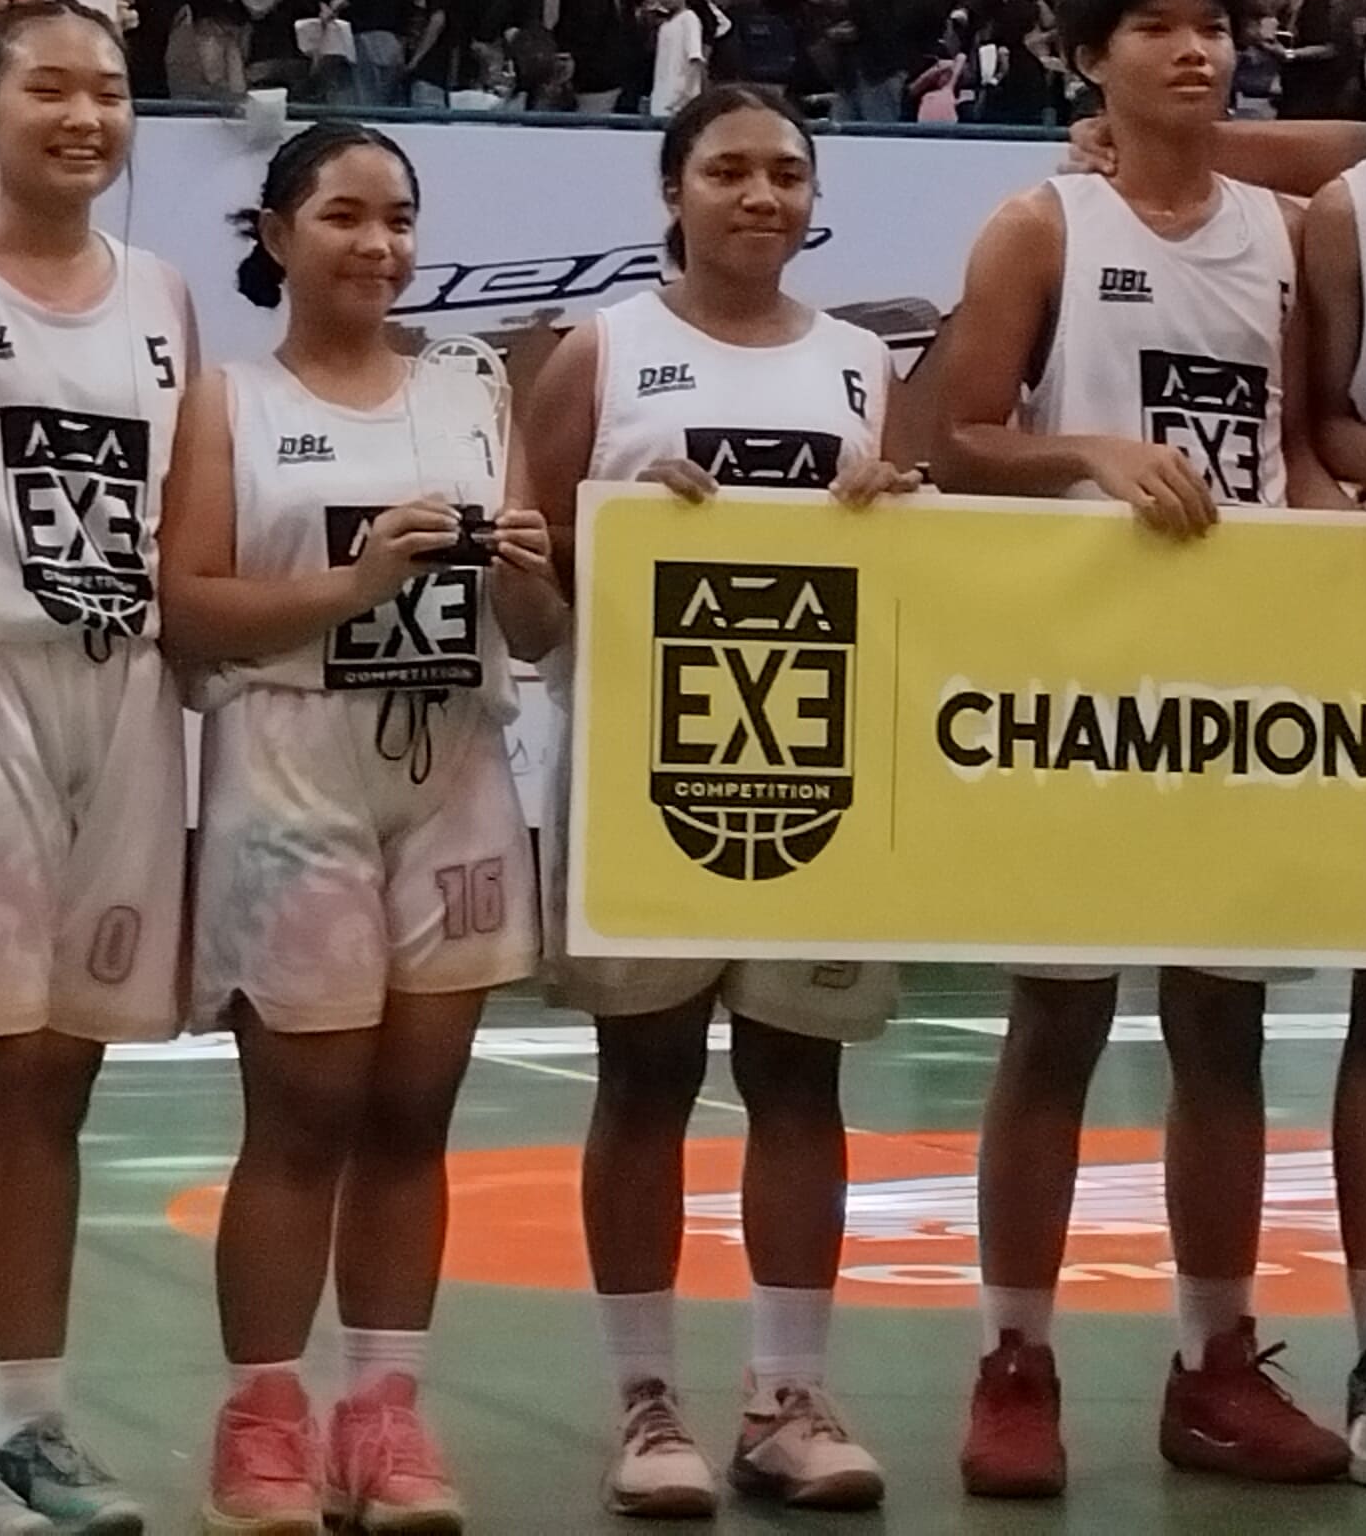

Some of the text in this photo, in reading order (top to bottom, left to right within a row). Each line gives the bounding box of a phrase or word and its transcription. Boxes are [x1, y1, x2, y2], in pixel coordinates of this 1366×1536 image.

[1098, 267, 1153, 294] DBL
[146, 335, 177, 390] 5
[637, 363, 695, 391] DBL
[841, 369, 868, 419] 6
[277, 433, 334, 457] DBL
[673, 781, 832, 801] COMPETITION
[437, 856, 504, 941] 16
[89, 904, 142, 985] 0
